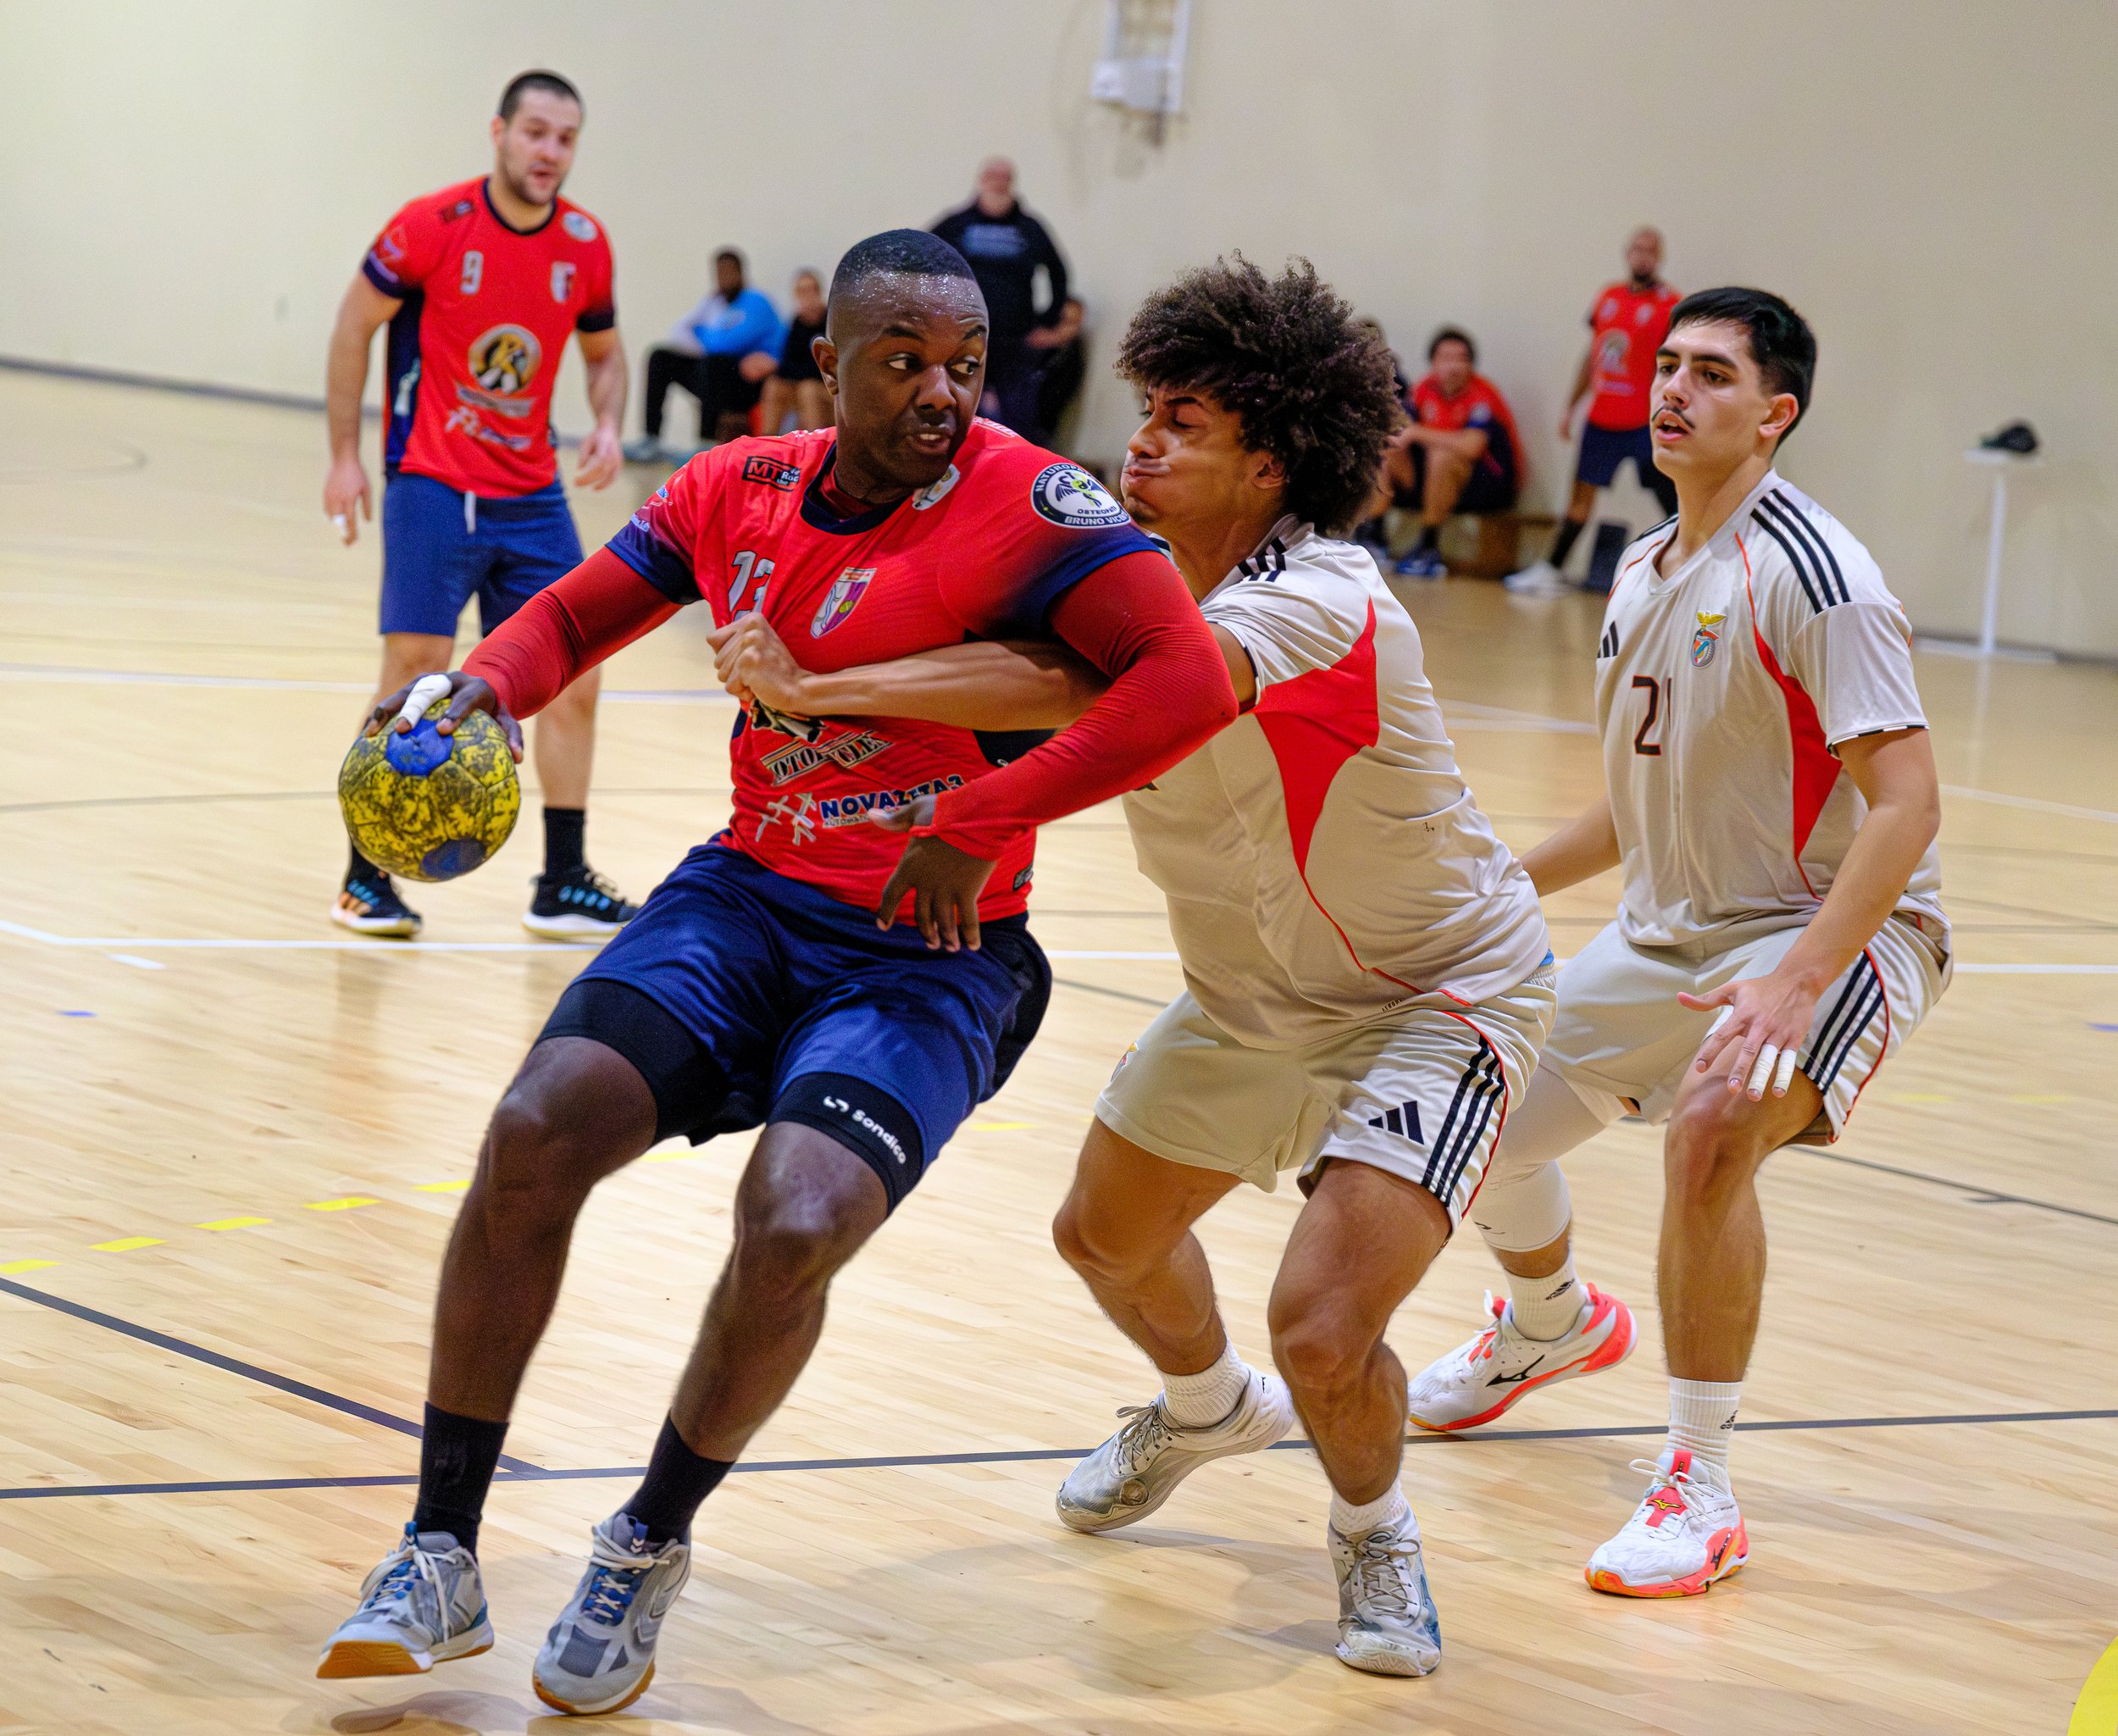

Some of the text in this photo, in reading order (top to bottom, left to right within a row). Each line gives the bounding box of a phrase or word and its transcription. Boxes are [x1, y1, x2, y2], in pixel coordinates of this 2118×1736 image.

[460, 249, 484, 295] 9
[748, 462, 782, 480] MT
[1064, 516, 1105, 525] BRUNO
